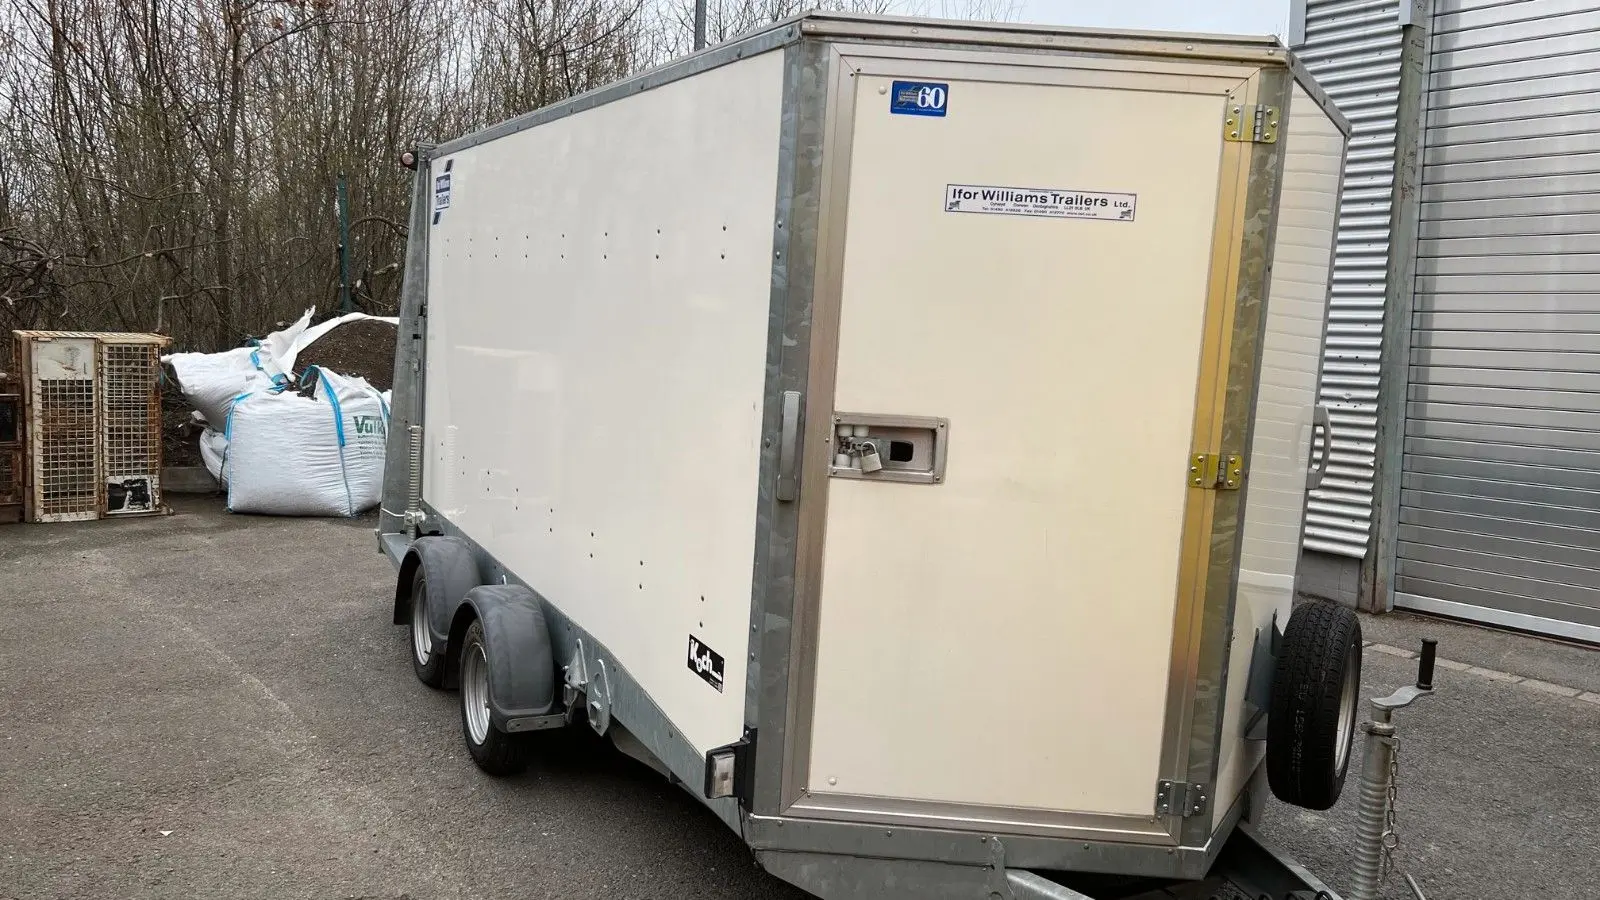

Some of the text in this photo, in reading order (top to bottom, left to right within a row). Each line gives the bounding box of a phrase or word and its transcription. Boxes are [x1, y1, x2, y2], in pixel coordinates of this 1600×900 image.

[917, 86, 946, 109] 60
[952, 188, 979, 200] Ifor
[981, 190, 1048, 204] Williams
[1051, 193, 1109, 207] Trailers
[690, 638, 713, 674] Koch
